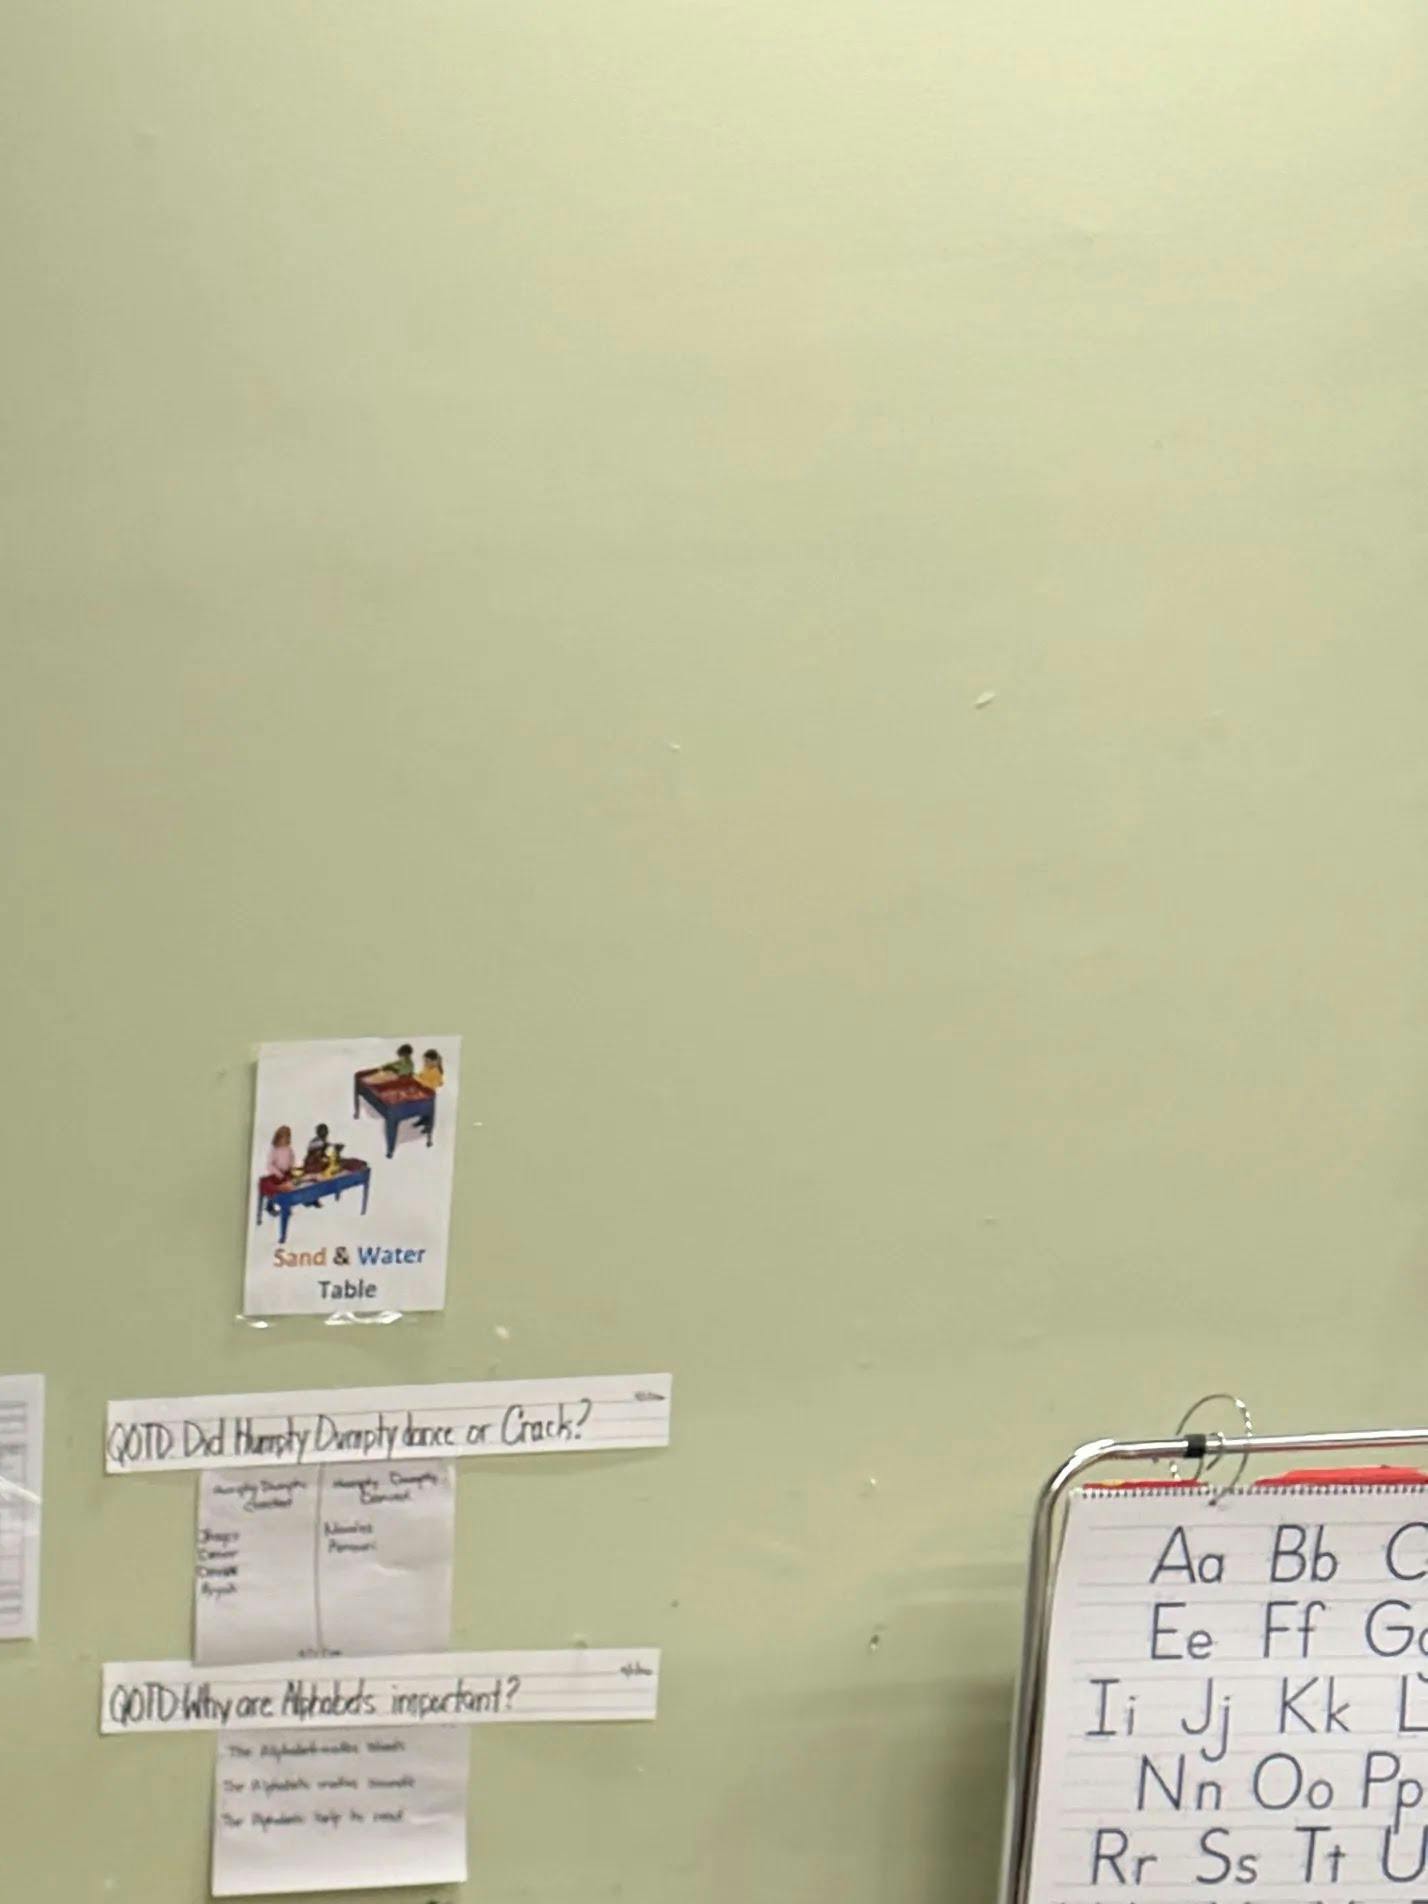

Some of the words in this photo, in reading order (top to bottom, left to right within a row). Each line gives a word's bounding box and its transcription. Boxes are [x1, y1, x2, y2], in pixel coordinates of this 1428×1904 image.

[272, 1247, 327, 1268] Sand
[332, 1246, 350, 1266] &
[357, 1246, 426, 1266] Water
[317, 1279, 377, 1300] Table
[183, 1416, 227, 1457] Did
[234, 1415, 311, 1464] Humpty
[314, 1411, 398, 1460] Dumpty
[402, 1411, 454, 1447] dance
[465, 1423, 492, 1443] or
[500, 1398, 593, 1446] Crack?
[1149, 1525, 1225, 1584] Aa
[1270, 1524, 1339, 1582] Bb
[1385, 1522, 1428, 1581] C
[1150, 1602, 1214, 1660] Ee
[1263, 1600, 1327, 1658] Ff
[182, 1680, 232, 1725] Why
[235, 1694, 274, 1719] are
[391, 1674, 521, 1719] important?
[1085, 1678, 1137, 1736] Ii
[1181, 1677, 1231, 1762] Jj
[1279, 1676, 1351, 1734] Kk
[1398, 1675, 1428, 1733] L
[1137, 1753, 1222, 1811] Nn
[1252, 1752, 1334, 1810] Oo
[1361, 1751, 1424, 1835] Pp
[1091, 1828, 1158, 1886] Rr
[1196, 1827, 1258, 1884] Ss
[1294, 1826, 1346, 1883] Tt
[1381, 1825, 1428, 1883] U
